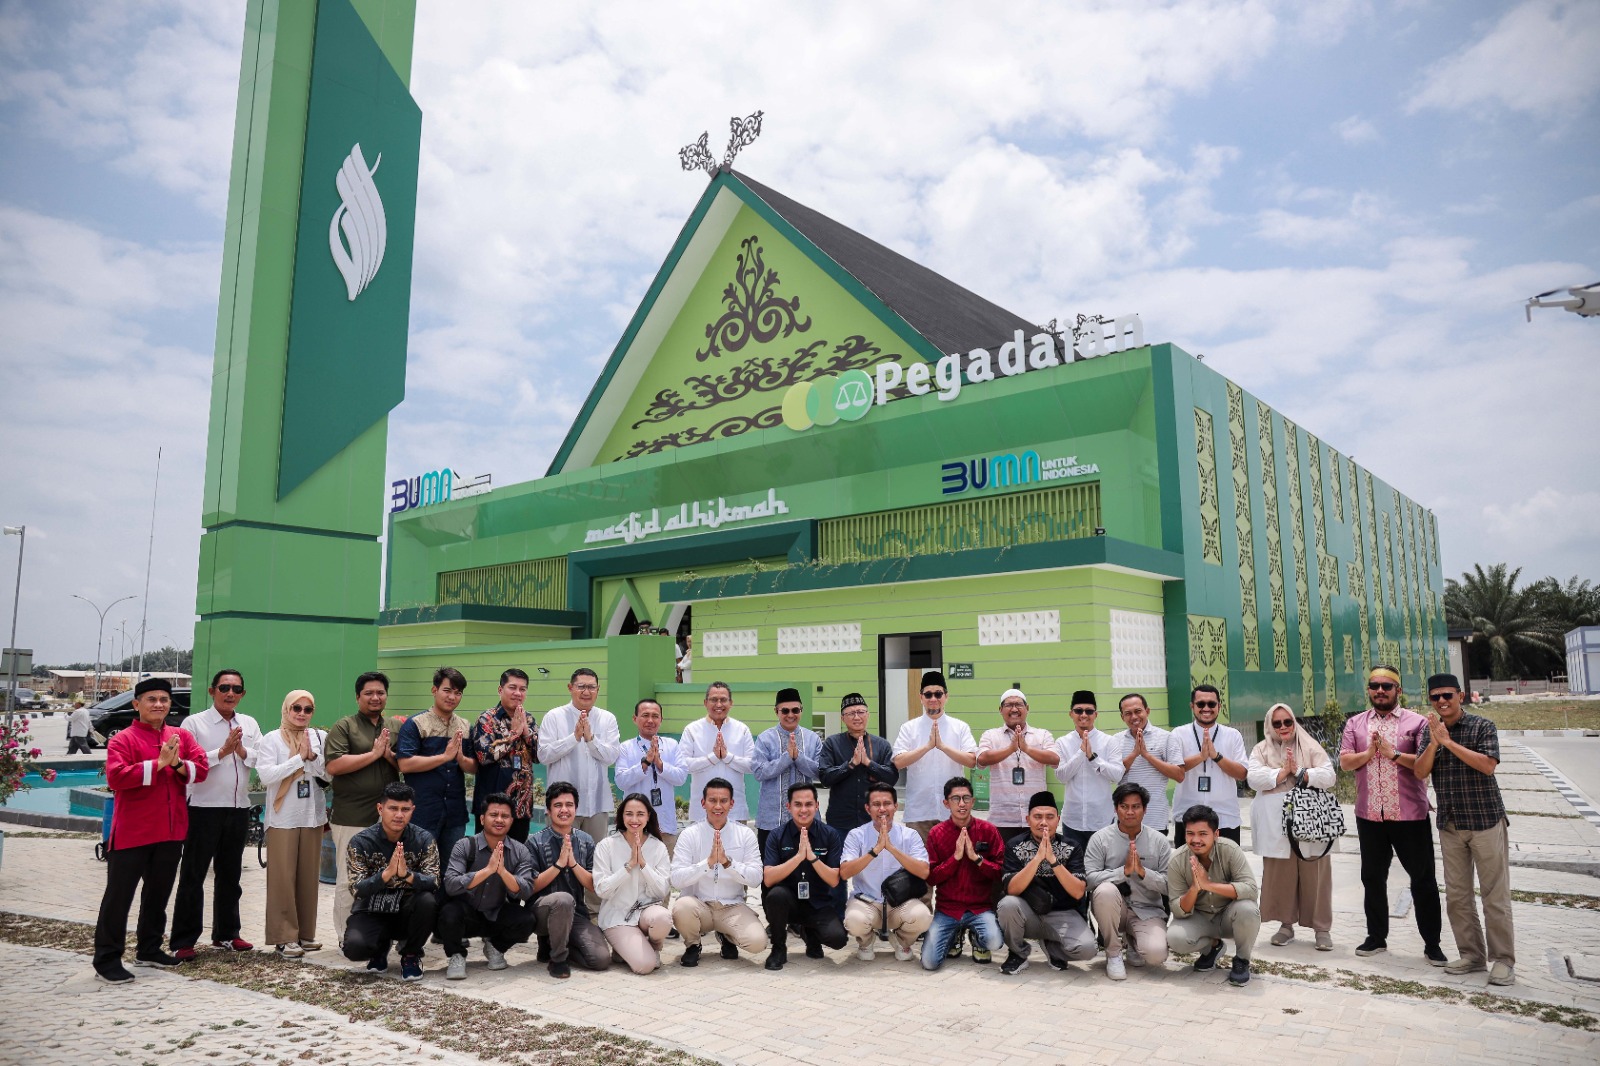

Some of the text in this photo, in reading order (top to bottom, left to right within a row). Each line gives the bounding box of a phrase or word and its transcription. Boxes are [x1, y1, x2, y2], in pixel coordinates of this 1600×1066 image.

[875, 313, 1145, 406] Pegadaian
[941, 450, 1041, 495] BUMN
[1042, 456, 1078, 470] UNTUK
[1042, 463, 1101, 481] INDONESIA
[391, 467, 453, 513] BUMN
[583, 508, 662, 544] masjid
